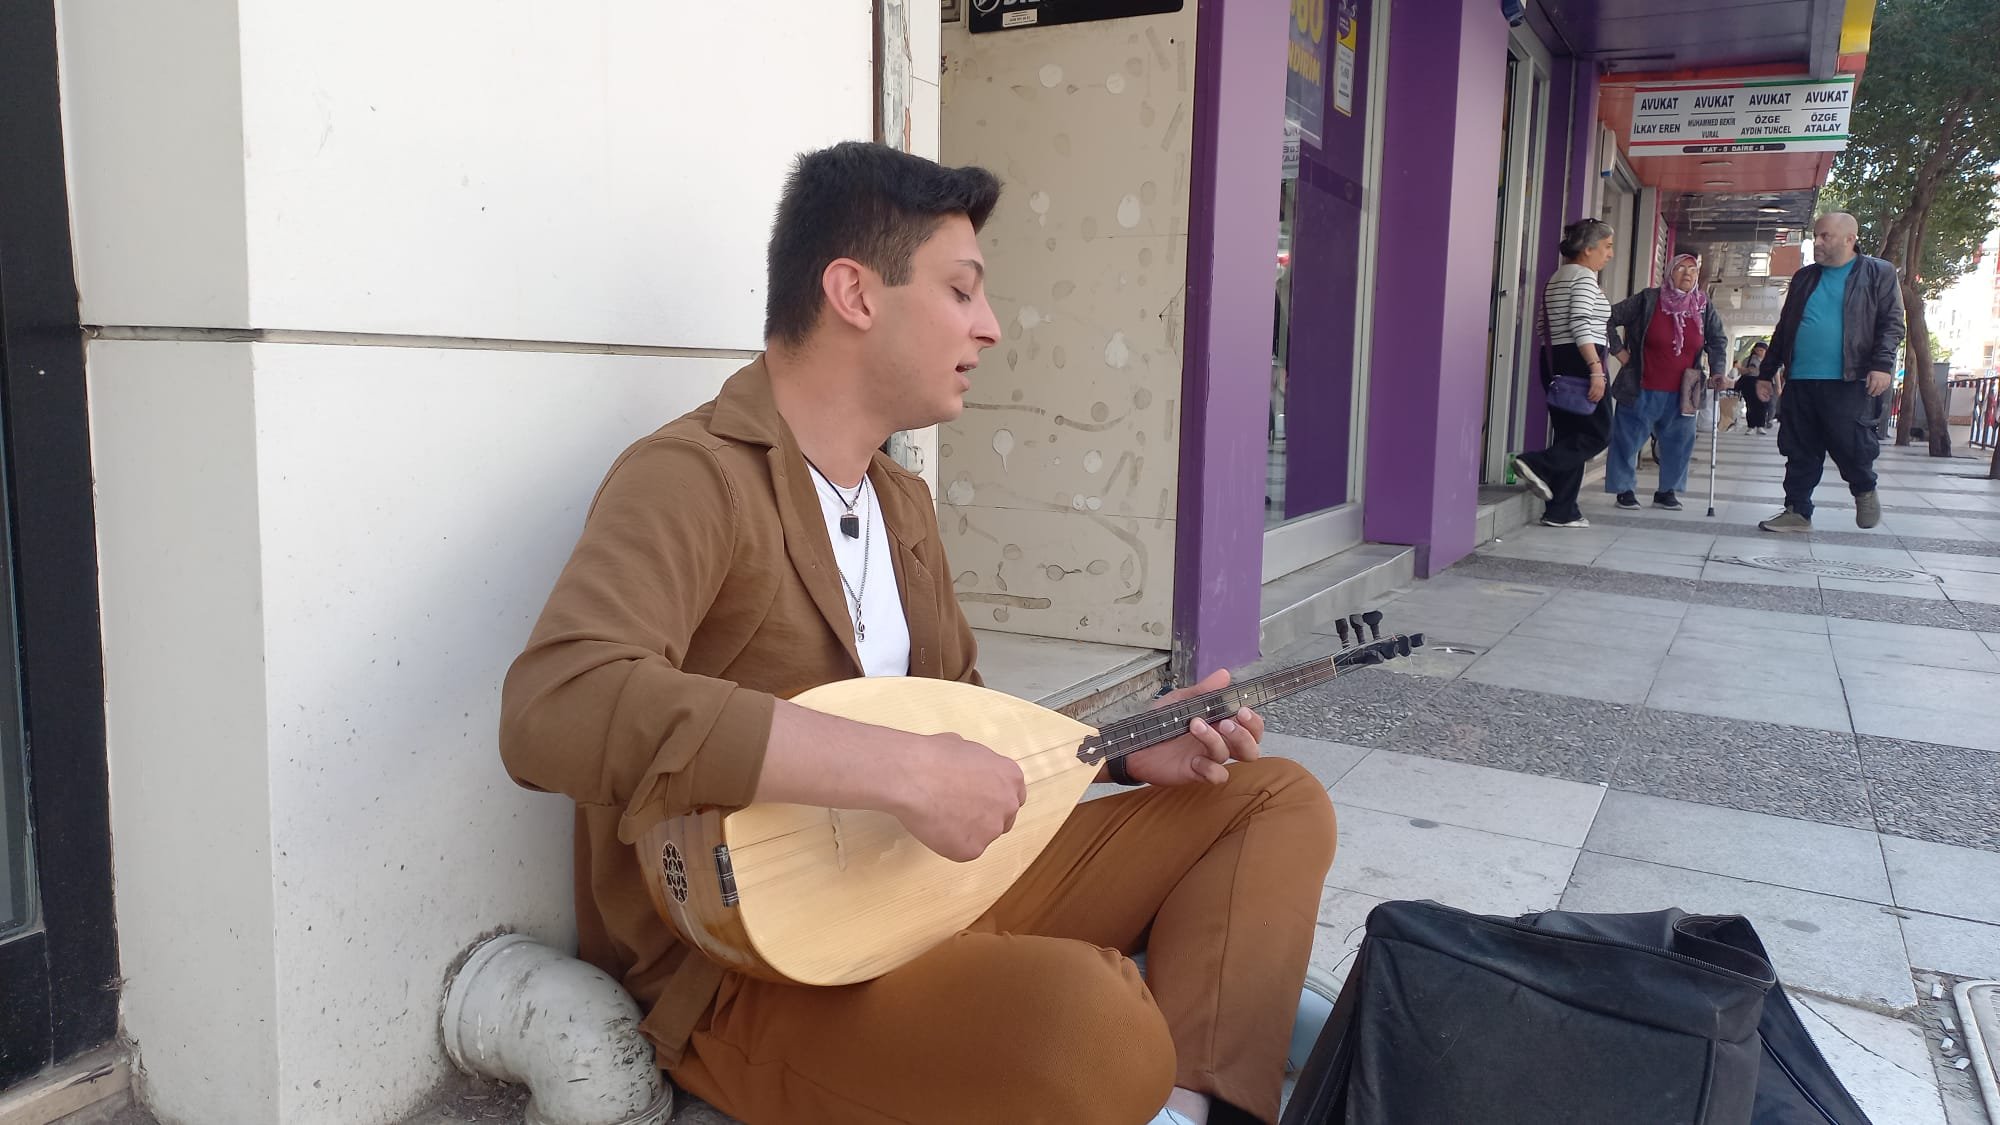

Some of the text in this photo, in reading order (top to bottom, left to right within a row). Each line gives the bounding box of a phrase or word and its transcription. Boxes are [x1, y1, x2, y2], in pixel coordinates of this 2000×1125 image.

[1694, 95, 1735, 109] AVUKAT
[1749, 92, 1792, 106] AVUKAT
[1805, 90, 1849, 104] AVUKAT
[1640, 97, 1679, 111] AVUKAT
[1754, 114, 1781, 124] ÖZGE
[1810, 113, 1838, 122] ÖZGE
[1633, 122, 1681, 135] İLKAY EREN
[1741, 125, 1792, 135] AYDIN TUNCEL
[1804, 122, 1842, 133] ATALAY
